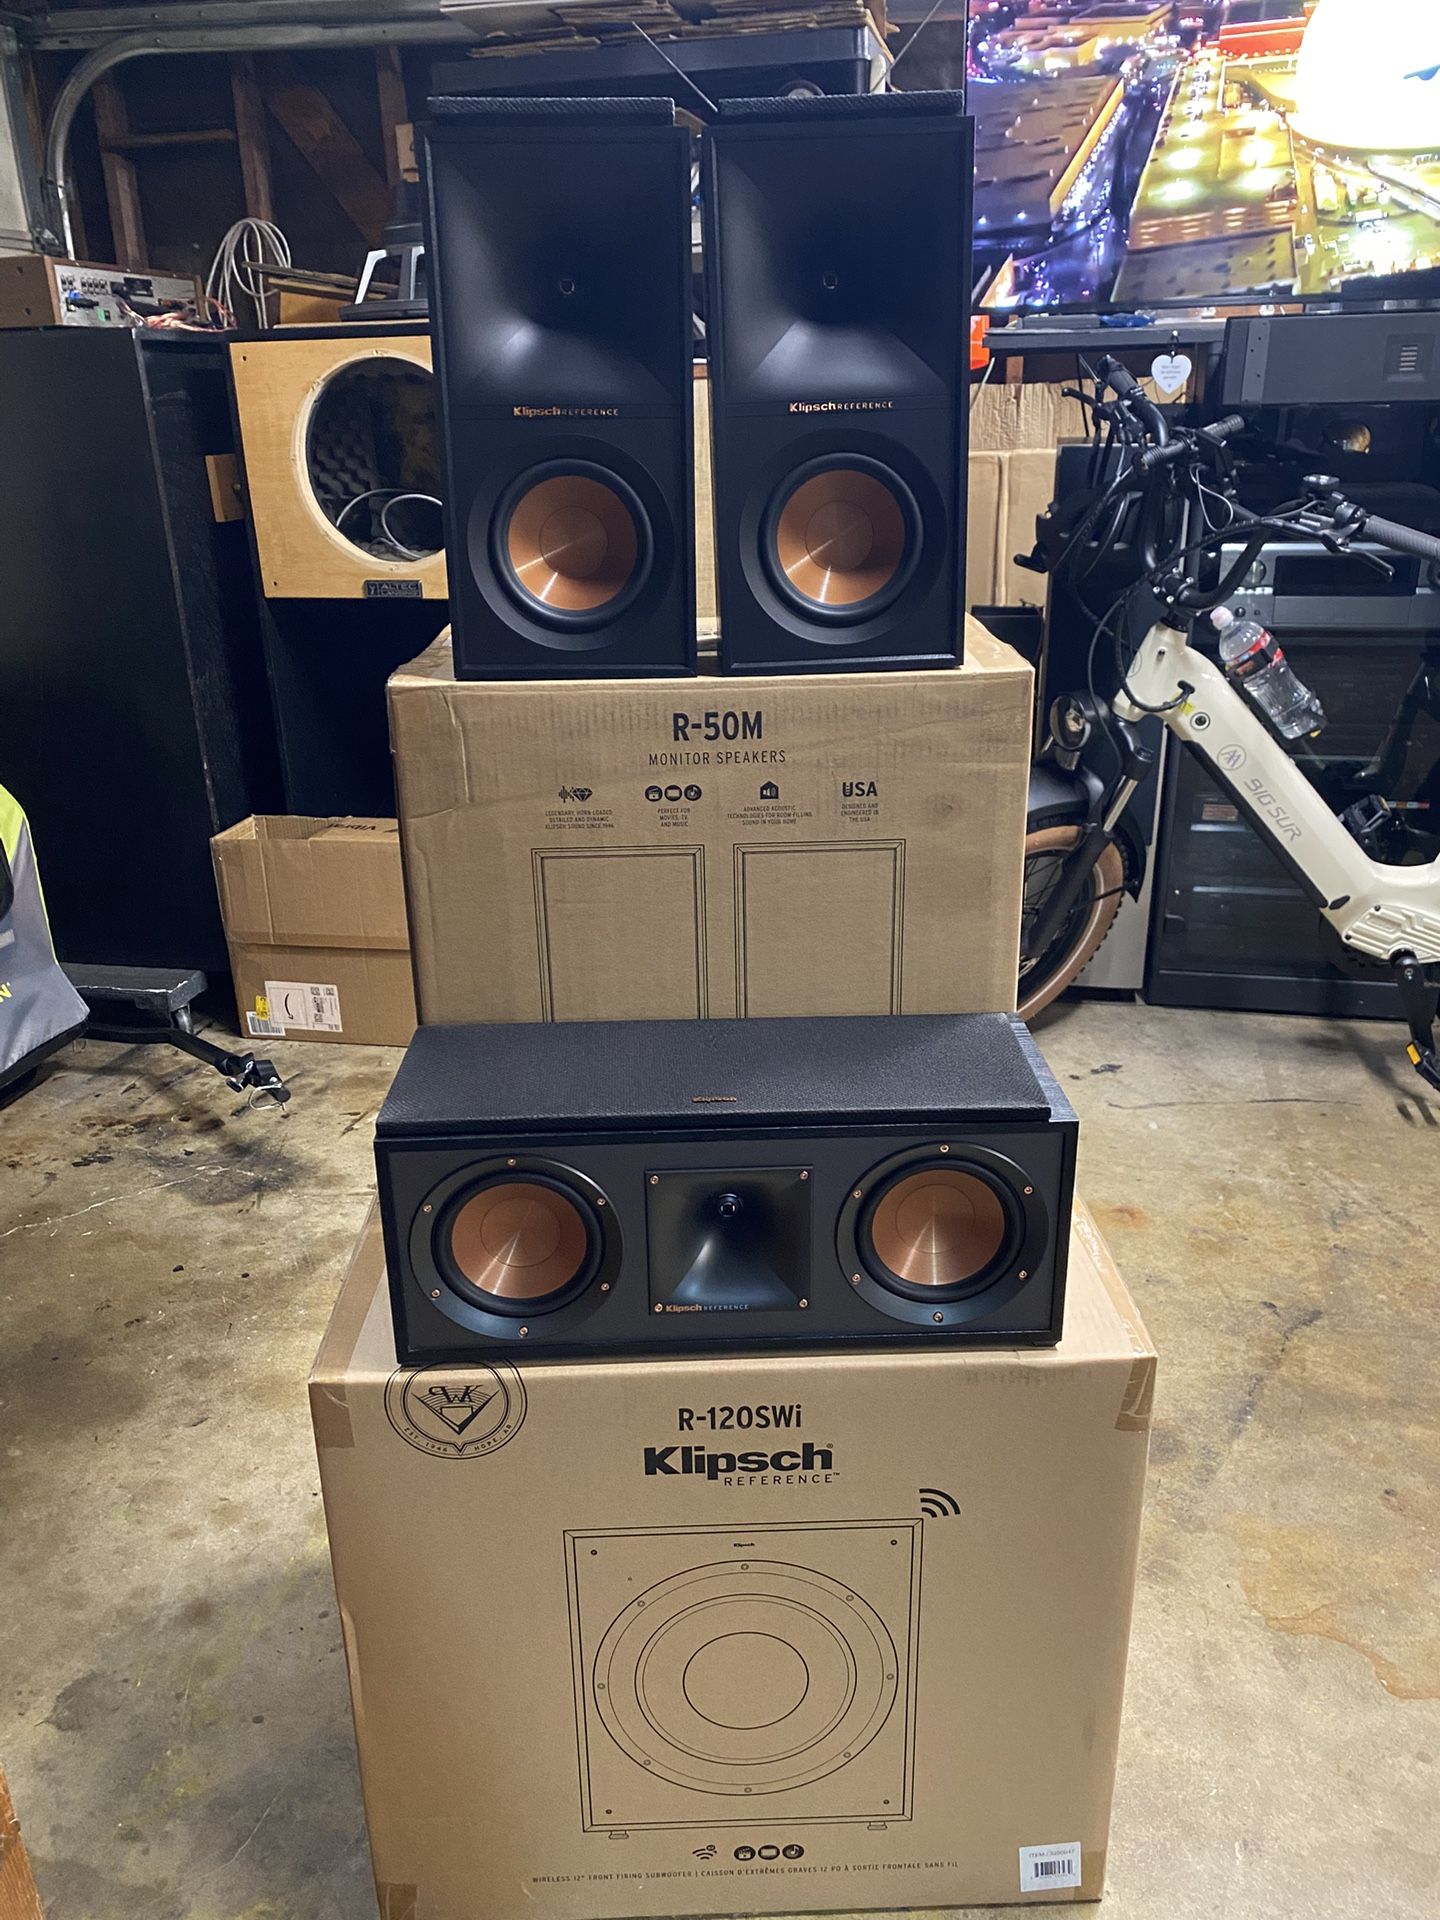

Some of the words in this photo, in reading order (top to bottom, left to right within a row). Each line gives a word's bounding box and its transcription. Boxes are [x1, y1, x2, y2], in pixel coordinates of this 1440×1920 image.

[513, 406, 560, 418] Klipsch
[562, 408, 618, 416] REFERENCE
[790, 401, 836, 413] Klipsch
[838, 401, 893, 410] REFERENCE
[673, 711, 762, 741] R-50M
[649, 752, 710, 765] MONITOR
[717, 750, 786, 764] SPEAKERS
[842, 781, 878, 797] USA
[1244, 778, 1276, 806] BIG
[1267, 807, 1302, 842] SUR
[666, 1304, 702, 1313] Klipsch
[679, 1404, 802, 1431] R-120SWi
[644, 1442, 833, 1480] Klipsch
[724, 1473, 833, 1486] REFERENCE
[532, 1875, 571, 1883] WIRELESS
[646, 1870, 692, 1878] SUBWOOFER
[701, 1869, 735, 1877] CAISSON
[788, 1865, 818, 1873] GRAVES
[852, 1863, 879, 1871] SORTIE
